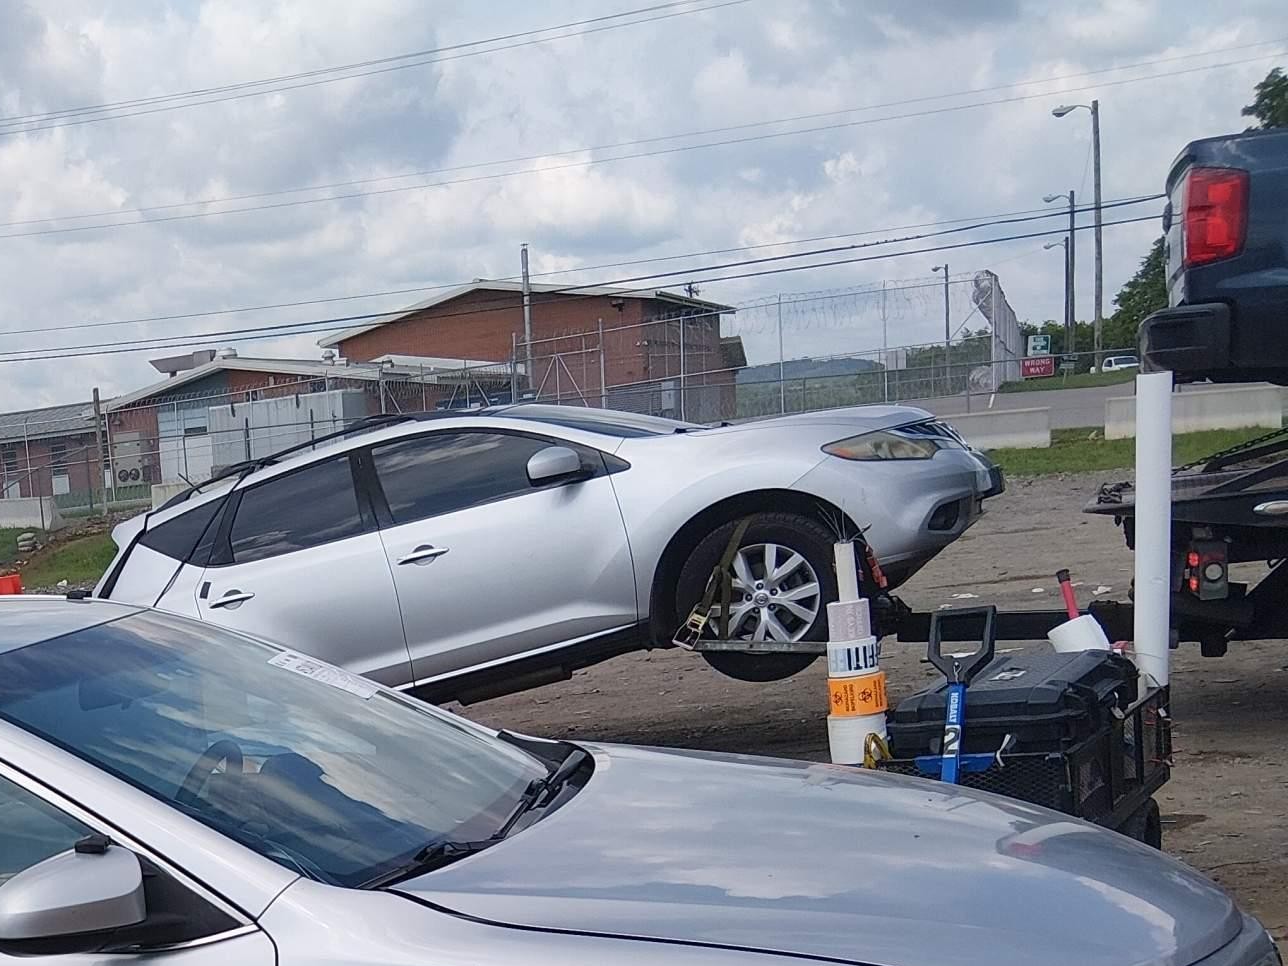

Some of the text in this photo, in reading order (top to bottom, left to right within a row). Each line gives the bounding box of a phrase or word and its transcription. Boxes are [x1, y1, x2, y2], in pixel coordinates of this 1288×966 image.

[1024, 359, 1050, 367] WRONG
[949, 692, 959, 723] KOBALT
[944, 727, 960, 755] 2
